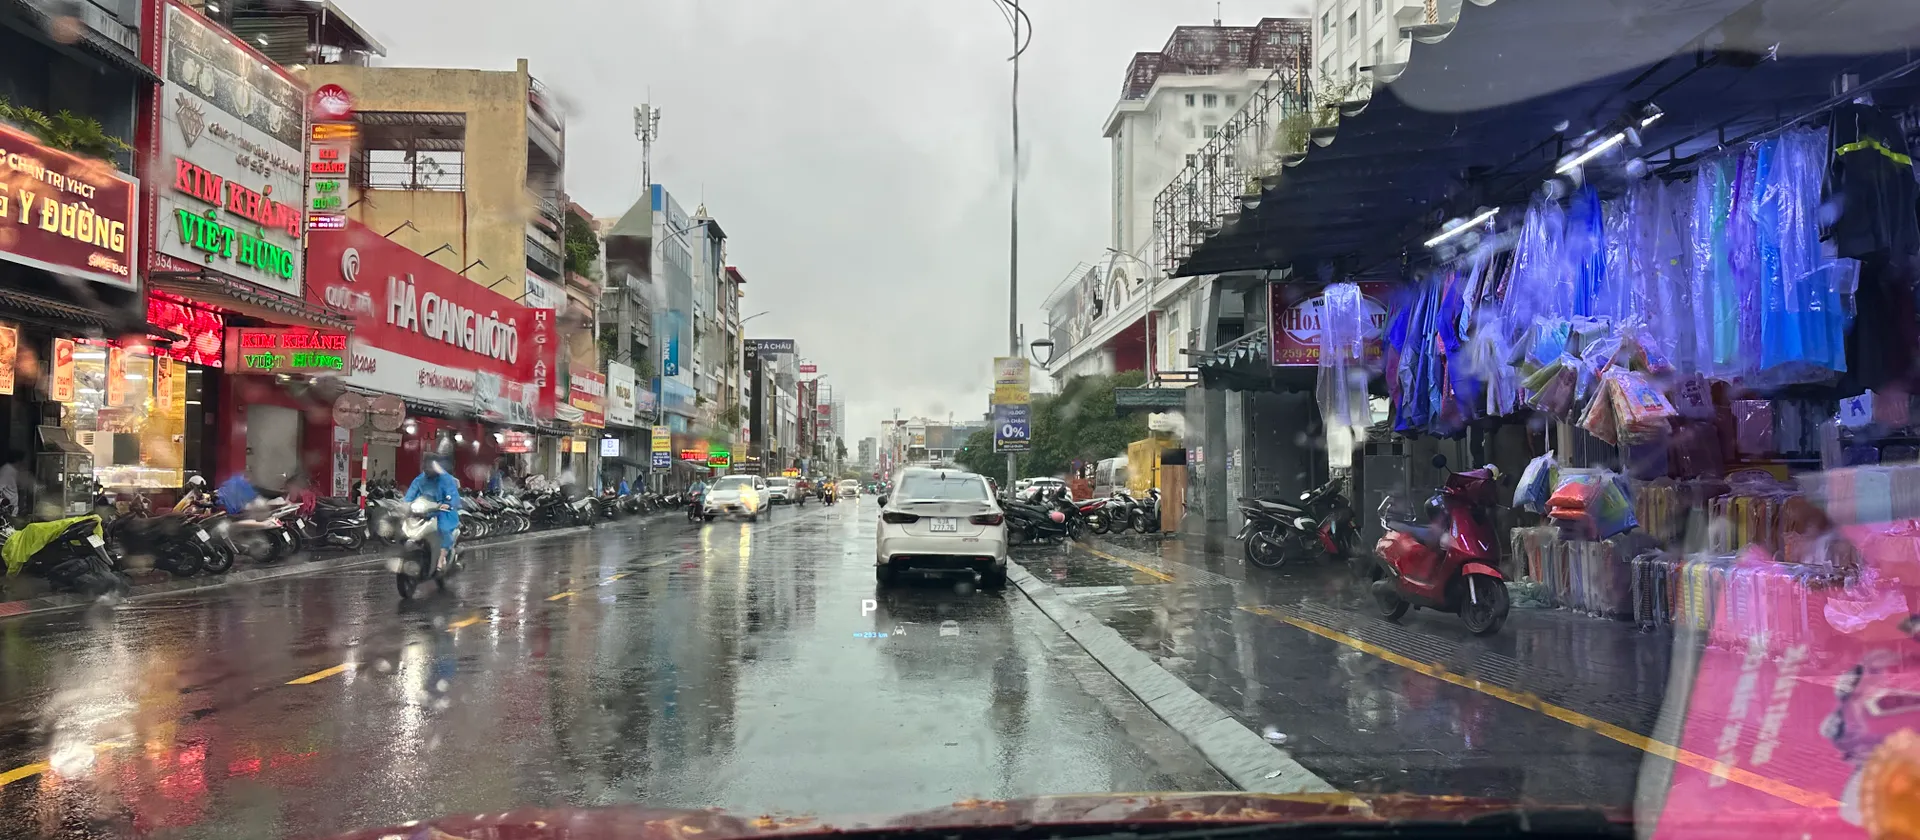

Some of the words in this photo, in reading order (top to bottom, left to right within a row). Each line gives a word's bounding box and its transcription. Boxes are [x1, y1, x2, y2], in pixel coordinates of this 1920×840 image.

[319, 148, 339, 160] KIM
[311, 160, 347, 173] KHÁNH
[46, 169, 65, 192] TRỊ
[67, 177, 96, 199] YHCT
[315, 180, 340, 194] VIỆT
[174, 157, 223, 207] KIM
[225, 183, 301, 240] KHÁNH
[19, 188, 36, 225] Y
[39, 196, 125, 253] ĐƯỜNG
[174, 209, 236, 264] VIỆT
[236, 227, 294, 280] HÙNG
[111, 261, 128, 276] 1945
[155, 253, 173, 270] 354
[387, 273, 419, 333] HÀ
[420, 291, 475, 351] GIANG
[474, 310, 519, 365] MÔTÔ
[535, 311, 547, 330] HÀ
[241, 333, 277, 349] KIM
[281, 330, 347, 350] KHÁNH
[770, 342, 792, 350] CHÂU
[244, 350, 286, 372] VIỆT
[291, 351, 344, 371] HÙNG
[535, 334, 547, 388] GIANG
[1002, 424, 1025, 438] 0%
[862, 599, 878, 617] P
